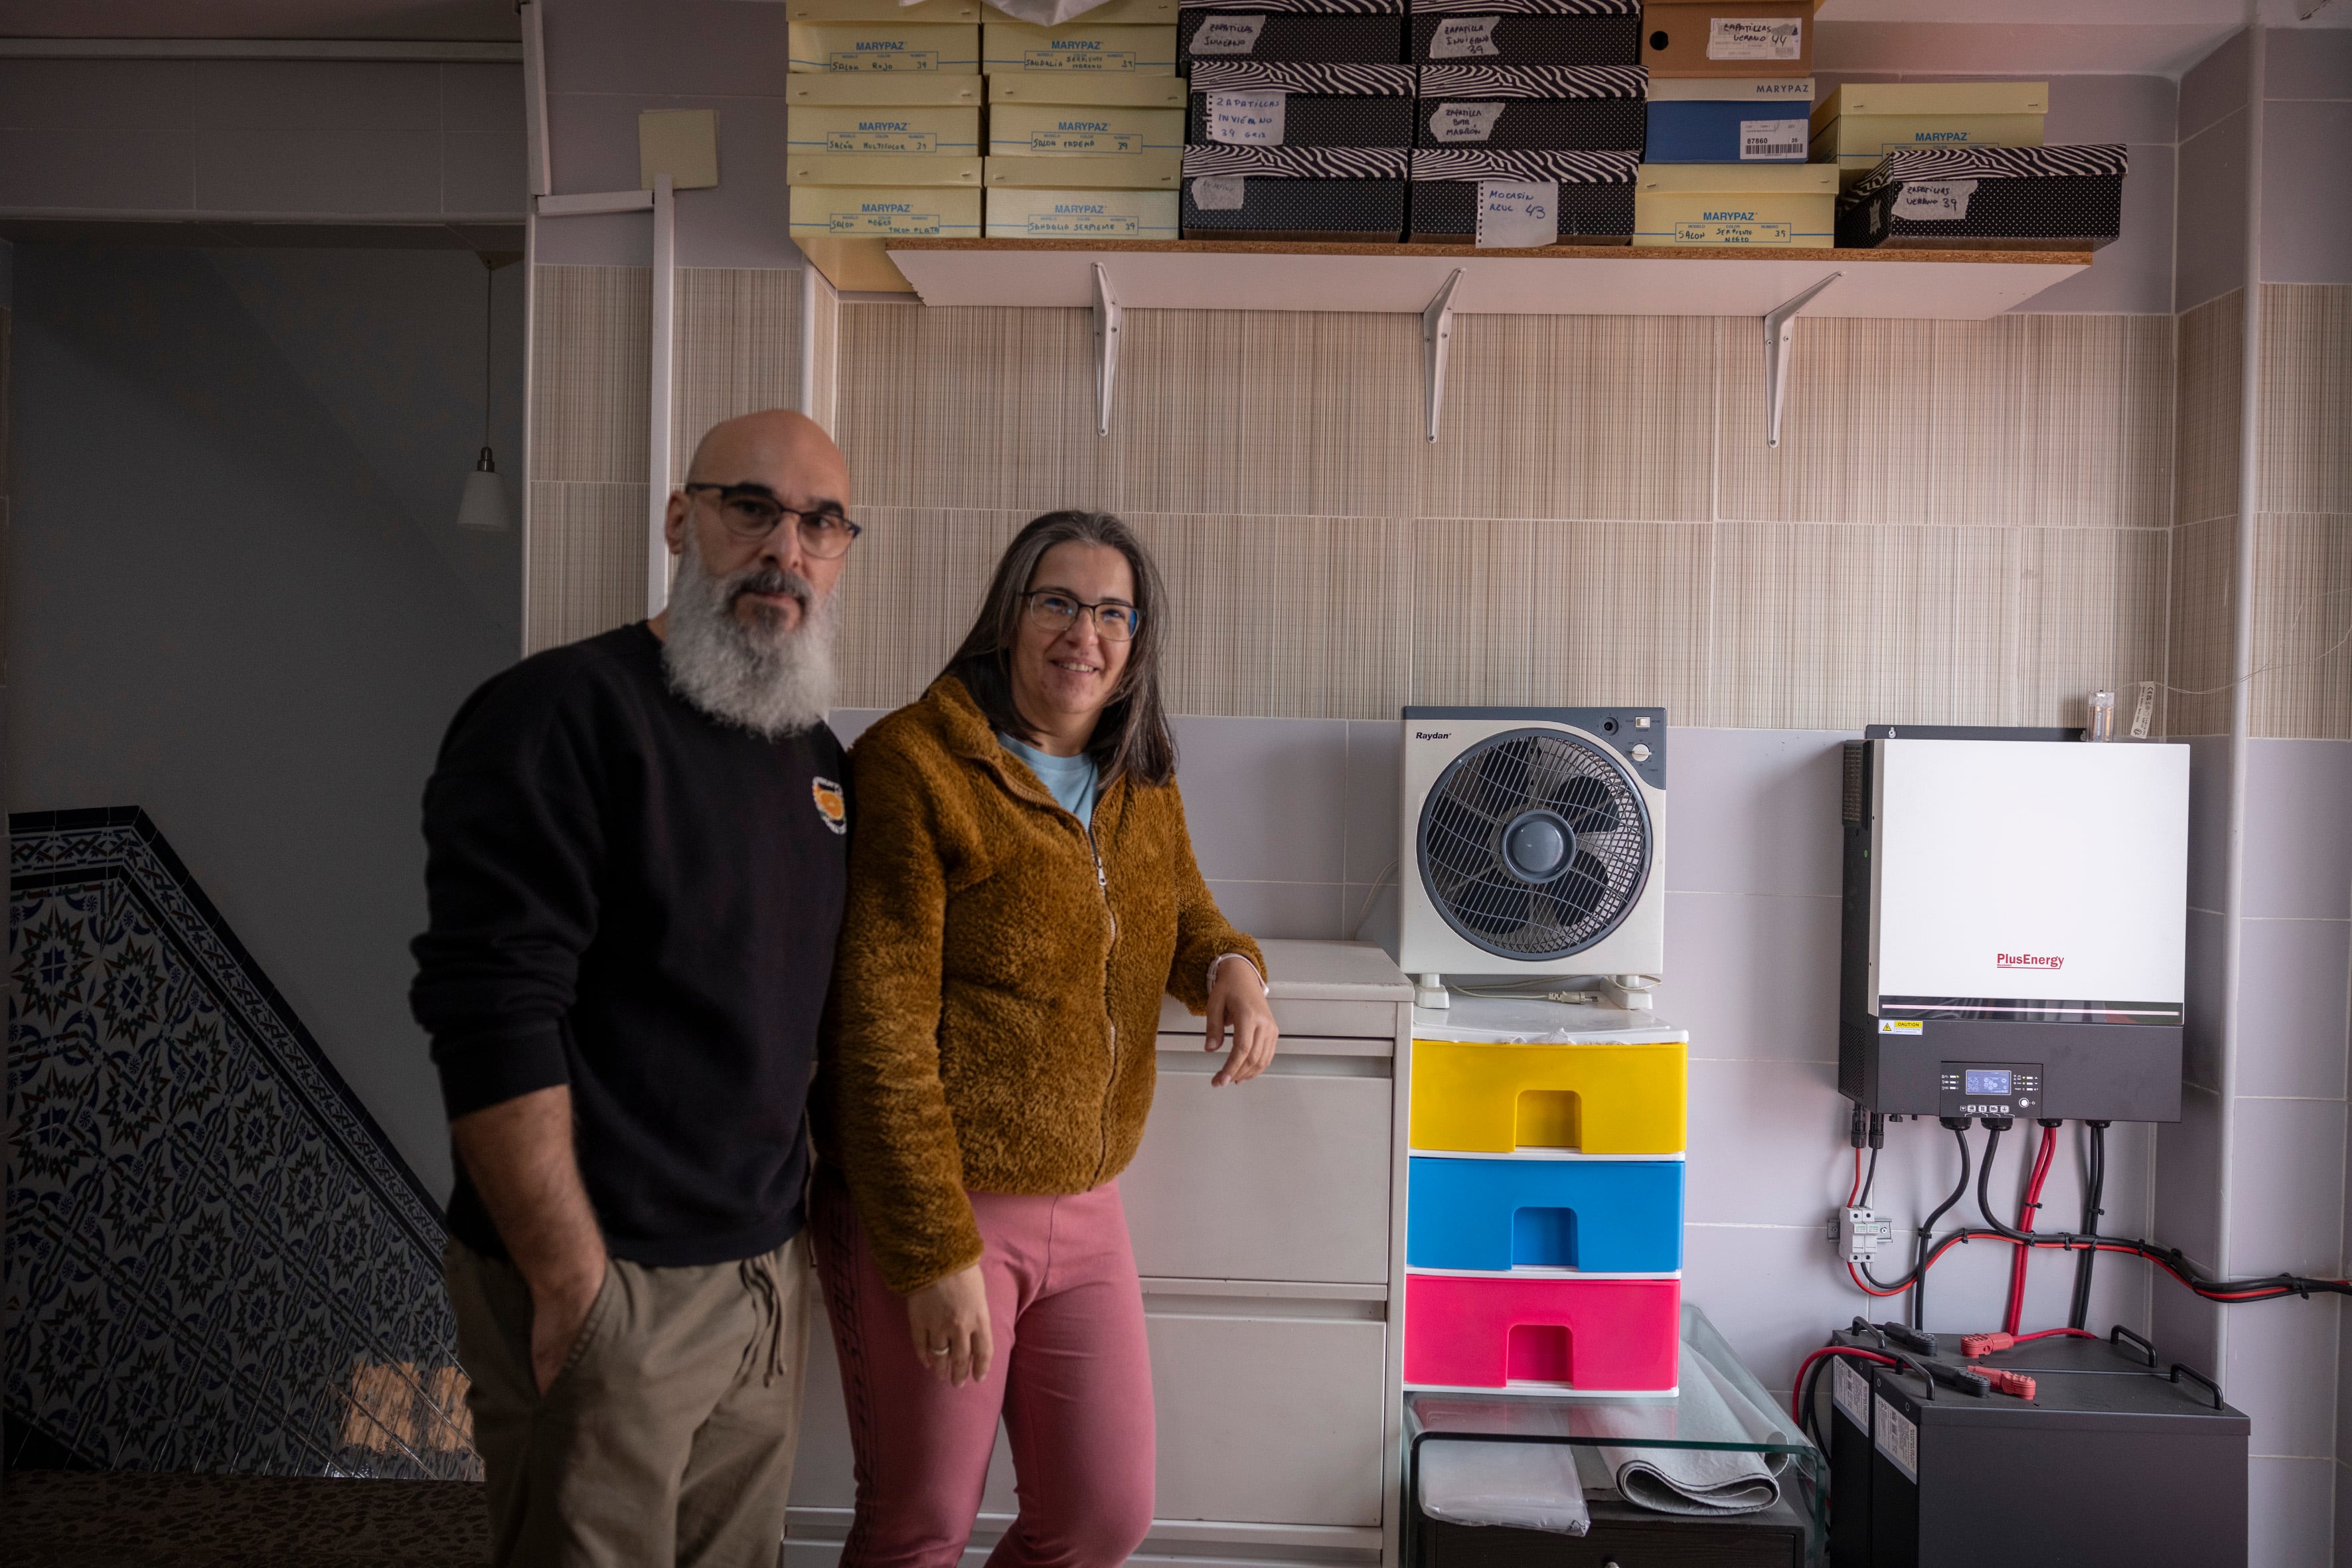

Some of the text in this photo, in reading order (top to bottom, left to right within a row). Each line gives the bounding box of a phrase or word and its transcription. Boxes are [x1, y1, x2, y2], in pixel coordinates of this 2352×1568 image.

[1772, 36, 1786, 46] 44
[856, 42, 903, 50] MARYPAZ
[1468, 45, 1483, 54] 39
[859, 122, 907, 131] MARYPAZ
[1058, 122, 1108, 131] MARYPAZ
[1221, 129, 1235, 137] 39
[862, 204, 910, 212] MARYPAZ
[1942, 198, 1957, 211] 39
[1526, 204, 1545, 219] 43
[1998, 953, 2064, 969] PlusEnergy
